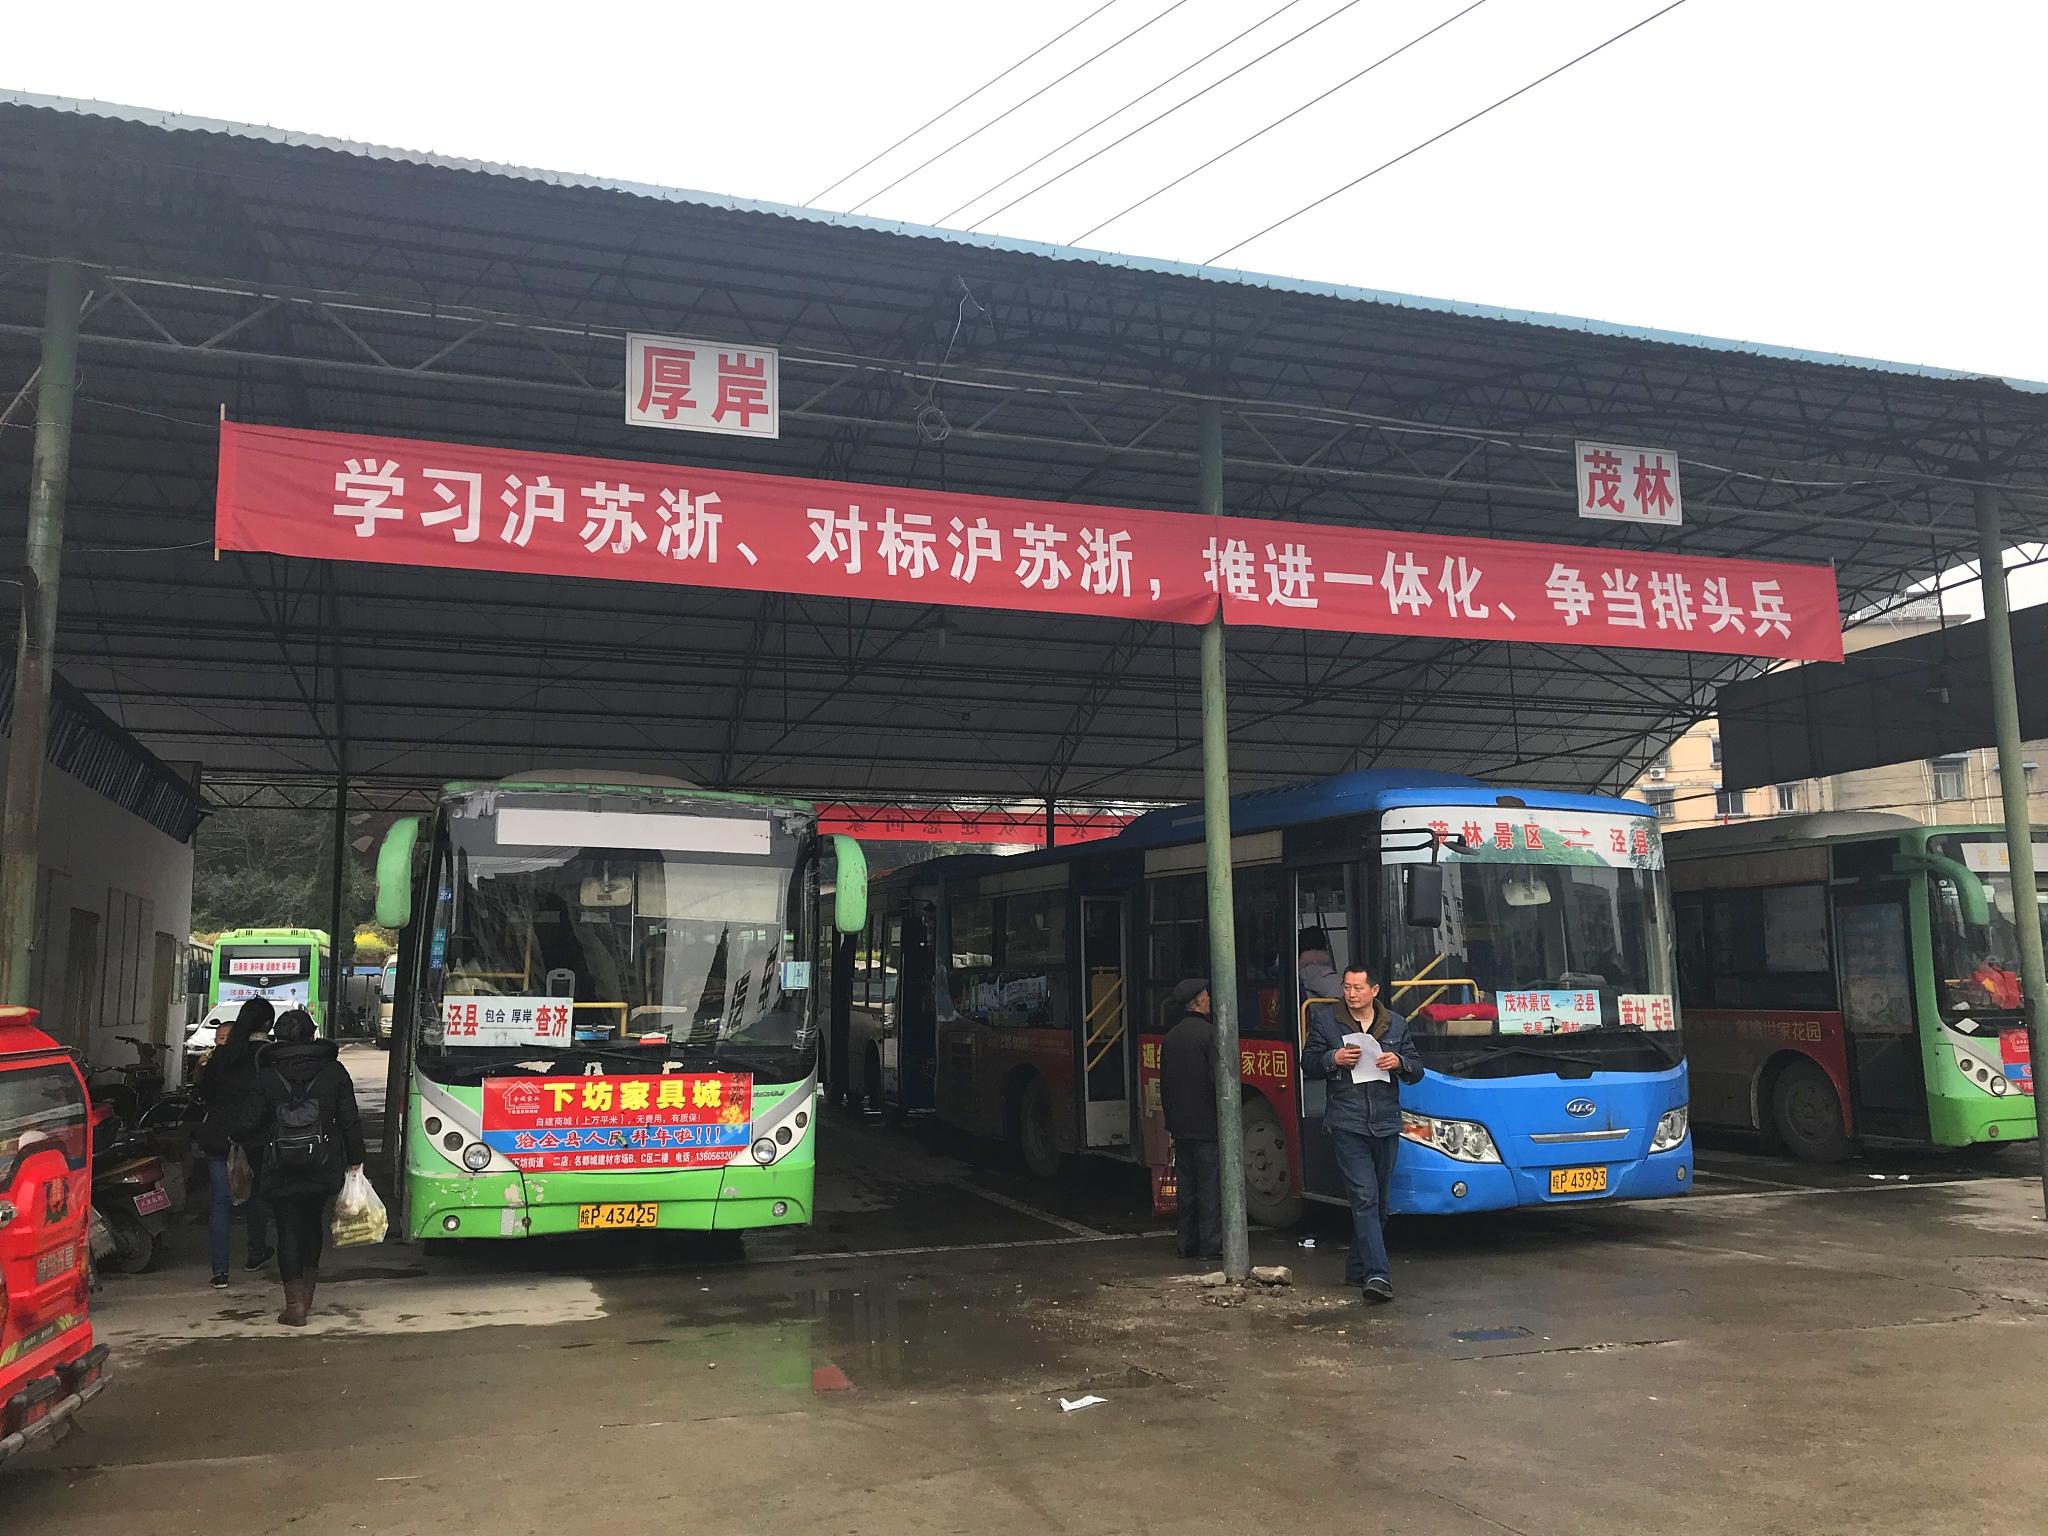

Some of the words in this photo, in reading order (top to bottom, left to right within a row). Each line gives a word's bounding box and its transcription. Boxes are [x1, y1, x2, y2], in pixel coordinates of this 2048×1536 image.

[637, 345, 769, 428] 厚岸
[1582, 448, 1675, 517] 茂林
[333, 457, 1793, 640] 学习沪苏浙、对标沪苏浙，推进一体化、争当排头兵
[1428, 821, 1544, 850] 茂林景区
[1609, 827, 1649, 855] 泾县
[1504, 993, 1551, 1012] 茂林景区
[1574, 993, 1595, 1012] 泾县
[1621, 998, 1646, 1031] 黄村
[446, 1003, 479, 1037] 泾县
[485, 1009, 506, 1023] 包合
[511, 1009, 532, 1023] 厚岸
[535, 1004, 569, 1037] 查济
[1522, 1021, 1544, 1035] 安吴
[544, 1079, 722, 1112] 下坊家具城
[580, 1206, 656, 1225] 皖P·43425
